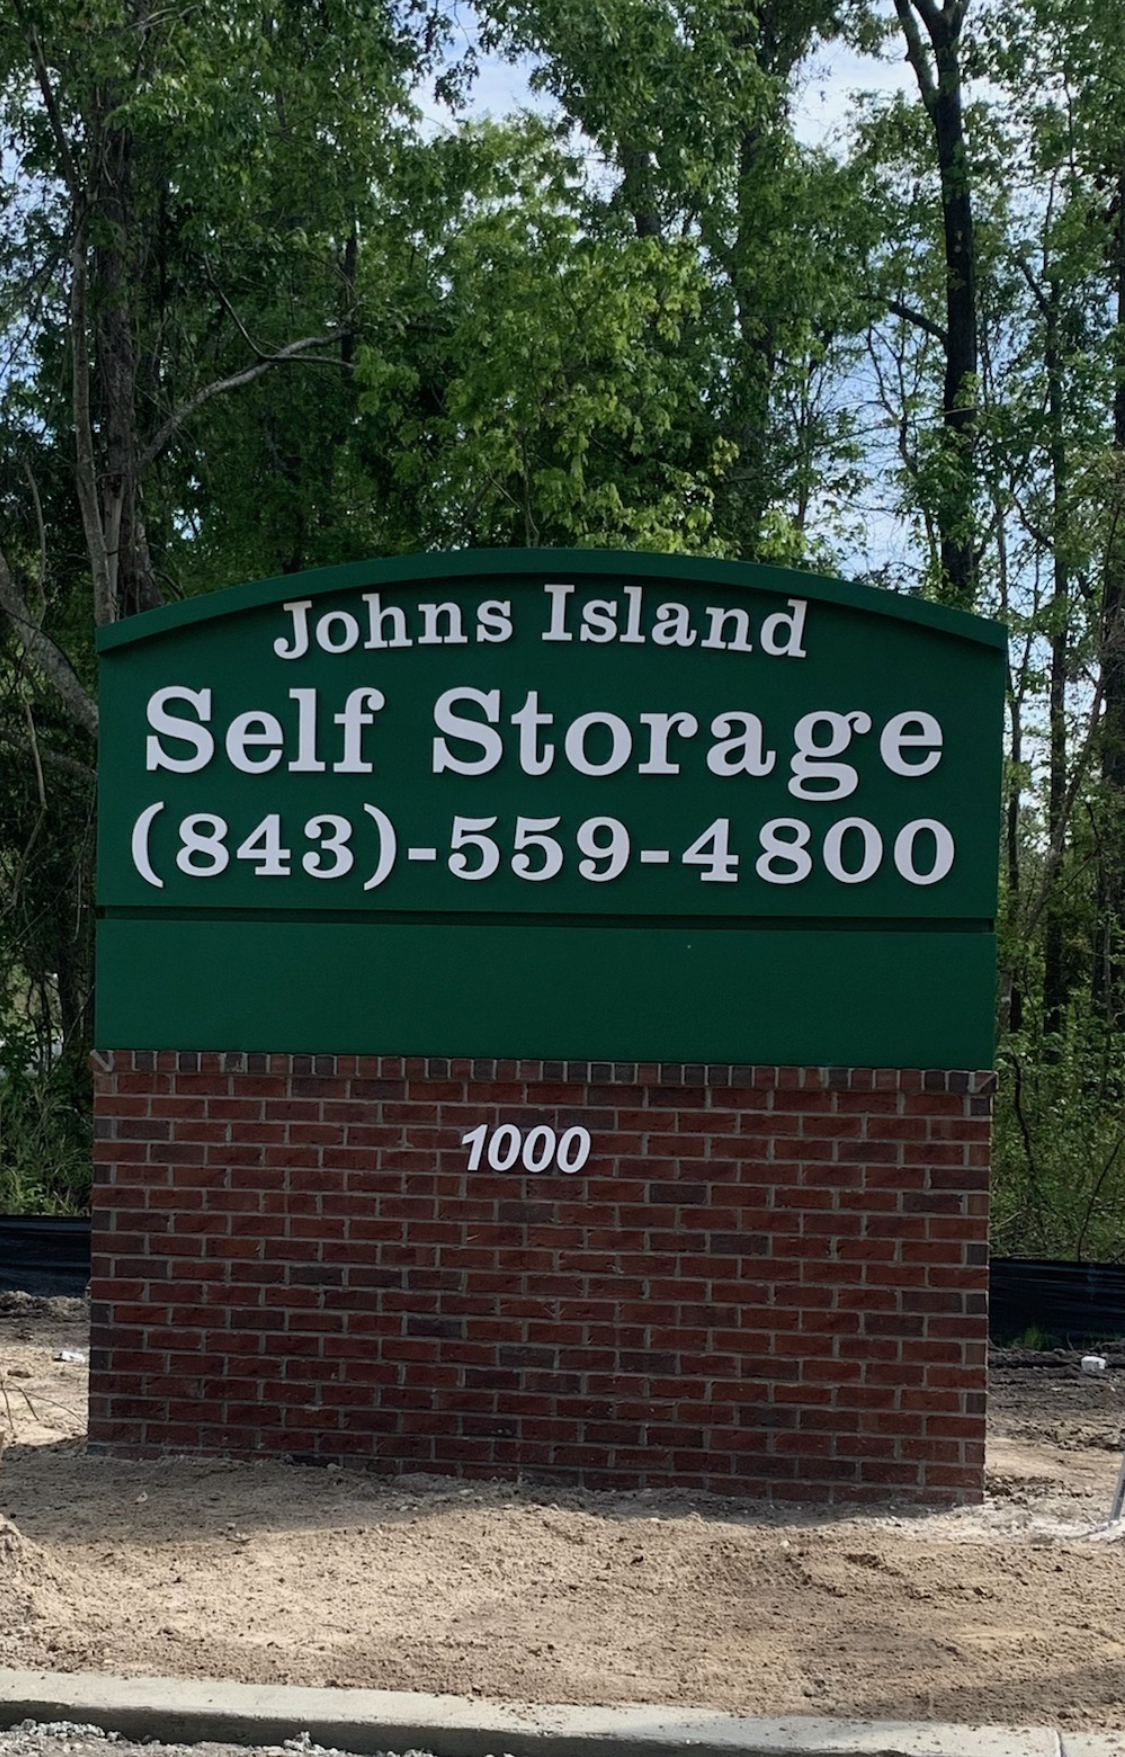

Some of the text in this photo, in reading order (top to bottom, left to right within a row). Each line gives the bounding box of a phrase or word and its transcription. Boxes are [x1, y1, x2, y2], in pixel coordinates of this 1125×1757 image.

[273, 584, 808, 660] Johns Island
[145, 686, 943, 802] Self Storage
[131, 801, 955, 891] (843)-559-4800
[461, 1123, 591, 1174] 1000
